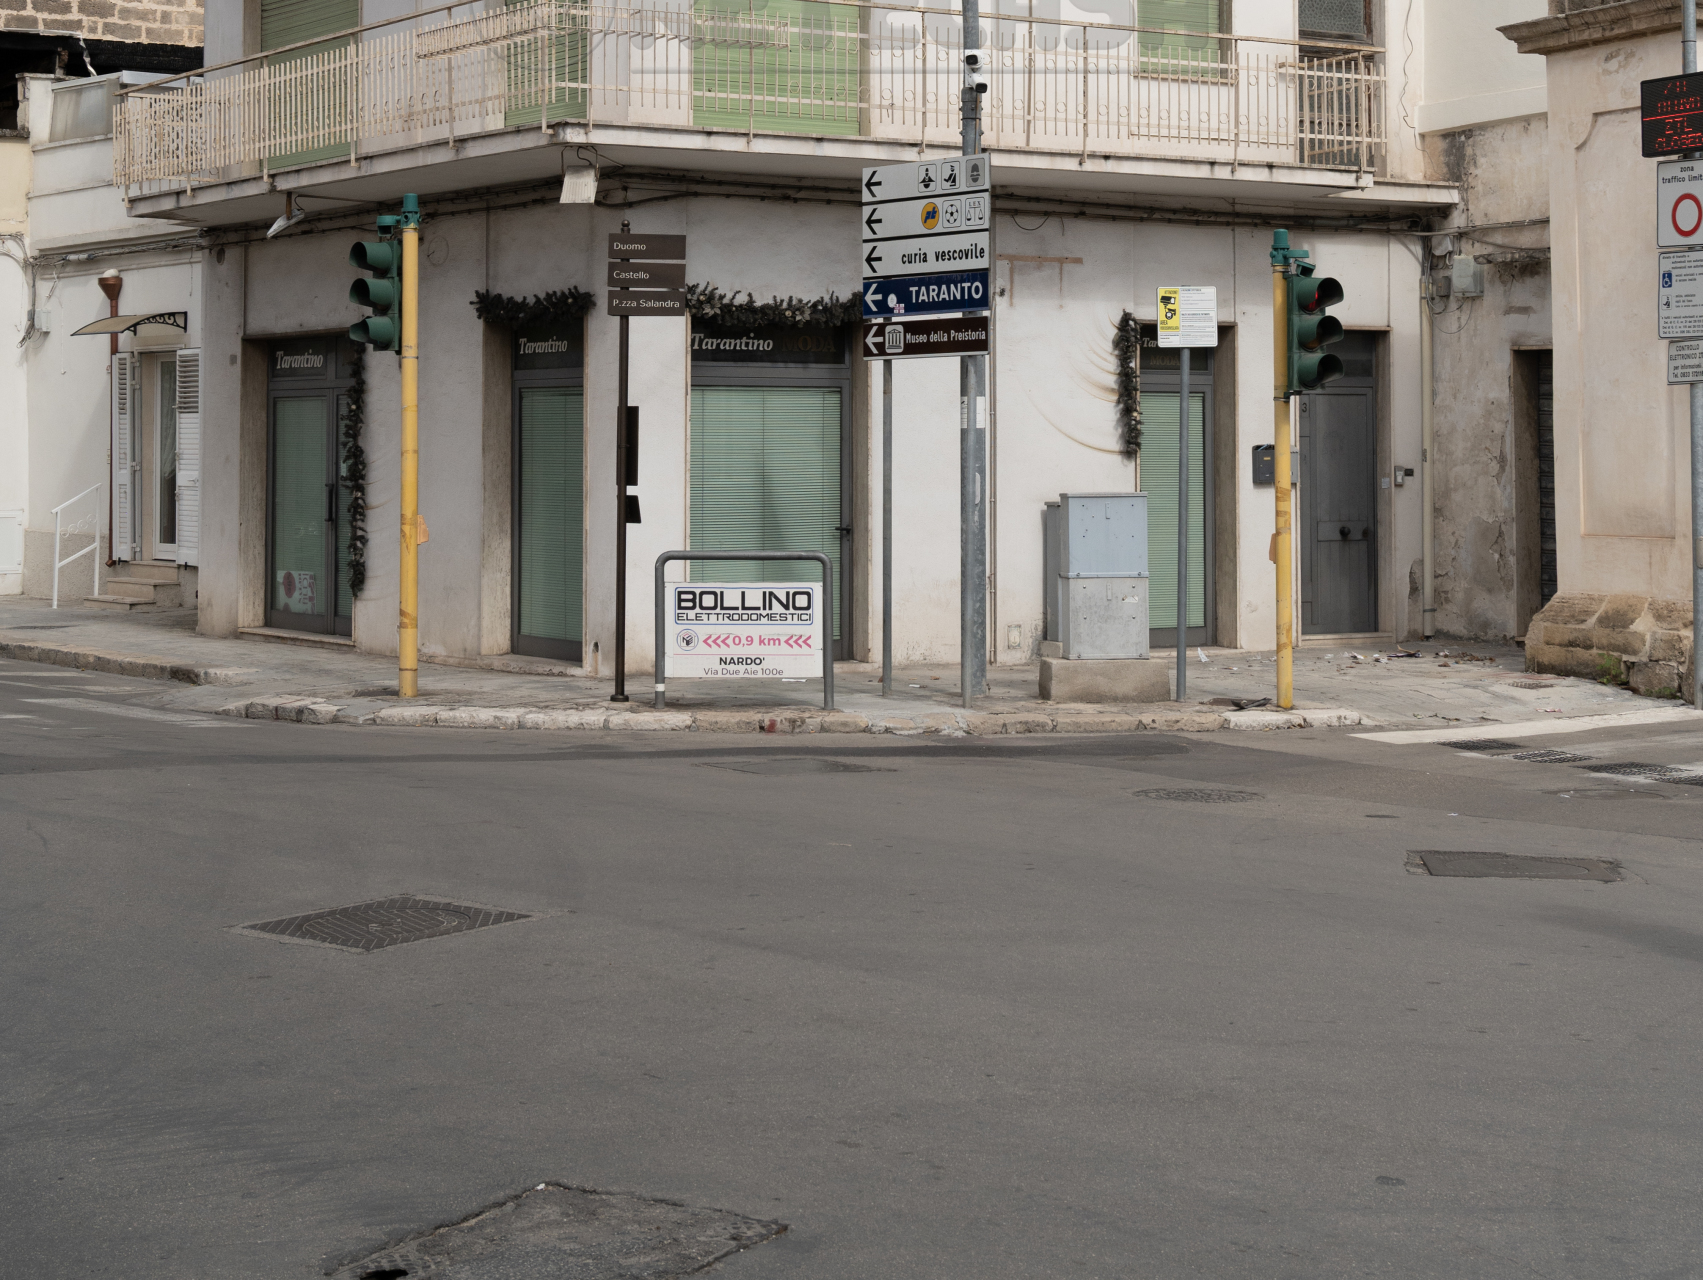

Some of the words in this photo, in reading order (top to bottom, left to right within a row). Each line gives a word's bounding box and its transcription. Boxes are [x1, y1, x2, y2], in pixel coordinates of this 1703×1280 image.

[1665, 117, 1693, 134] ZTL
[1680, 165, 1694, 173] zona
[1662, 175, 1686, 184] traffico
[613, 241, 647, 251] Duomo
[901, 248, 928, 265] curia
[934, 242, 986, 262] vescovile
[613, 270, 650, 280] Castello
[909, 281, 984, 304] TARANTO
[613, 298, 638, 308] P.zza
[639, 298, 680, 308] Salandra
[691, 332, 773, 350] Tarantino
[905, 331, 928, 344] Museo
[929, 330, 948, 343] della
[950, 328, 987, 342] Preistoria
[518, 335, 568, 354] Tarantino
[276, 348, 324, 370] Tarantino
[1301, 402, 1308, 413] 3
[676, 590, 812, 611] BOLLINO
[676, 612, 812, 622] ELETTRODOMESTICI
[732, 635, 754, 648] 0,9
[758, 634, 782, 646] km
[719, 657, 766, 666] NARDO'
[703, 667, 719, 676] Via
[721, 667, 741, 676] Due
[743, 667, 759, 676] Aie
[761, 667, 784, 676] 100e
